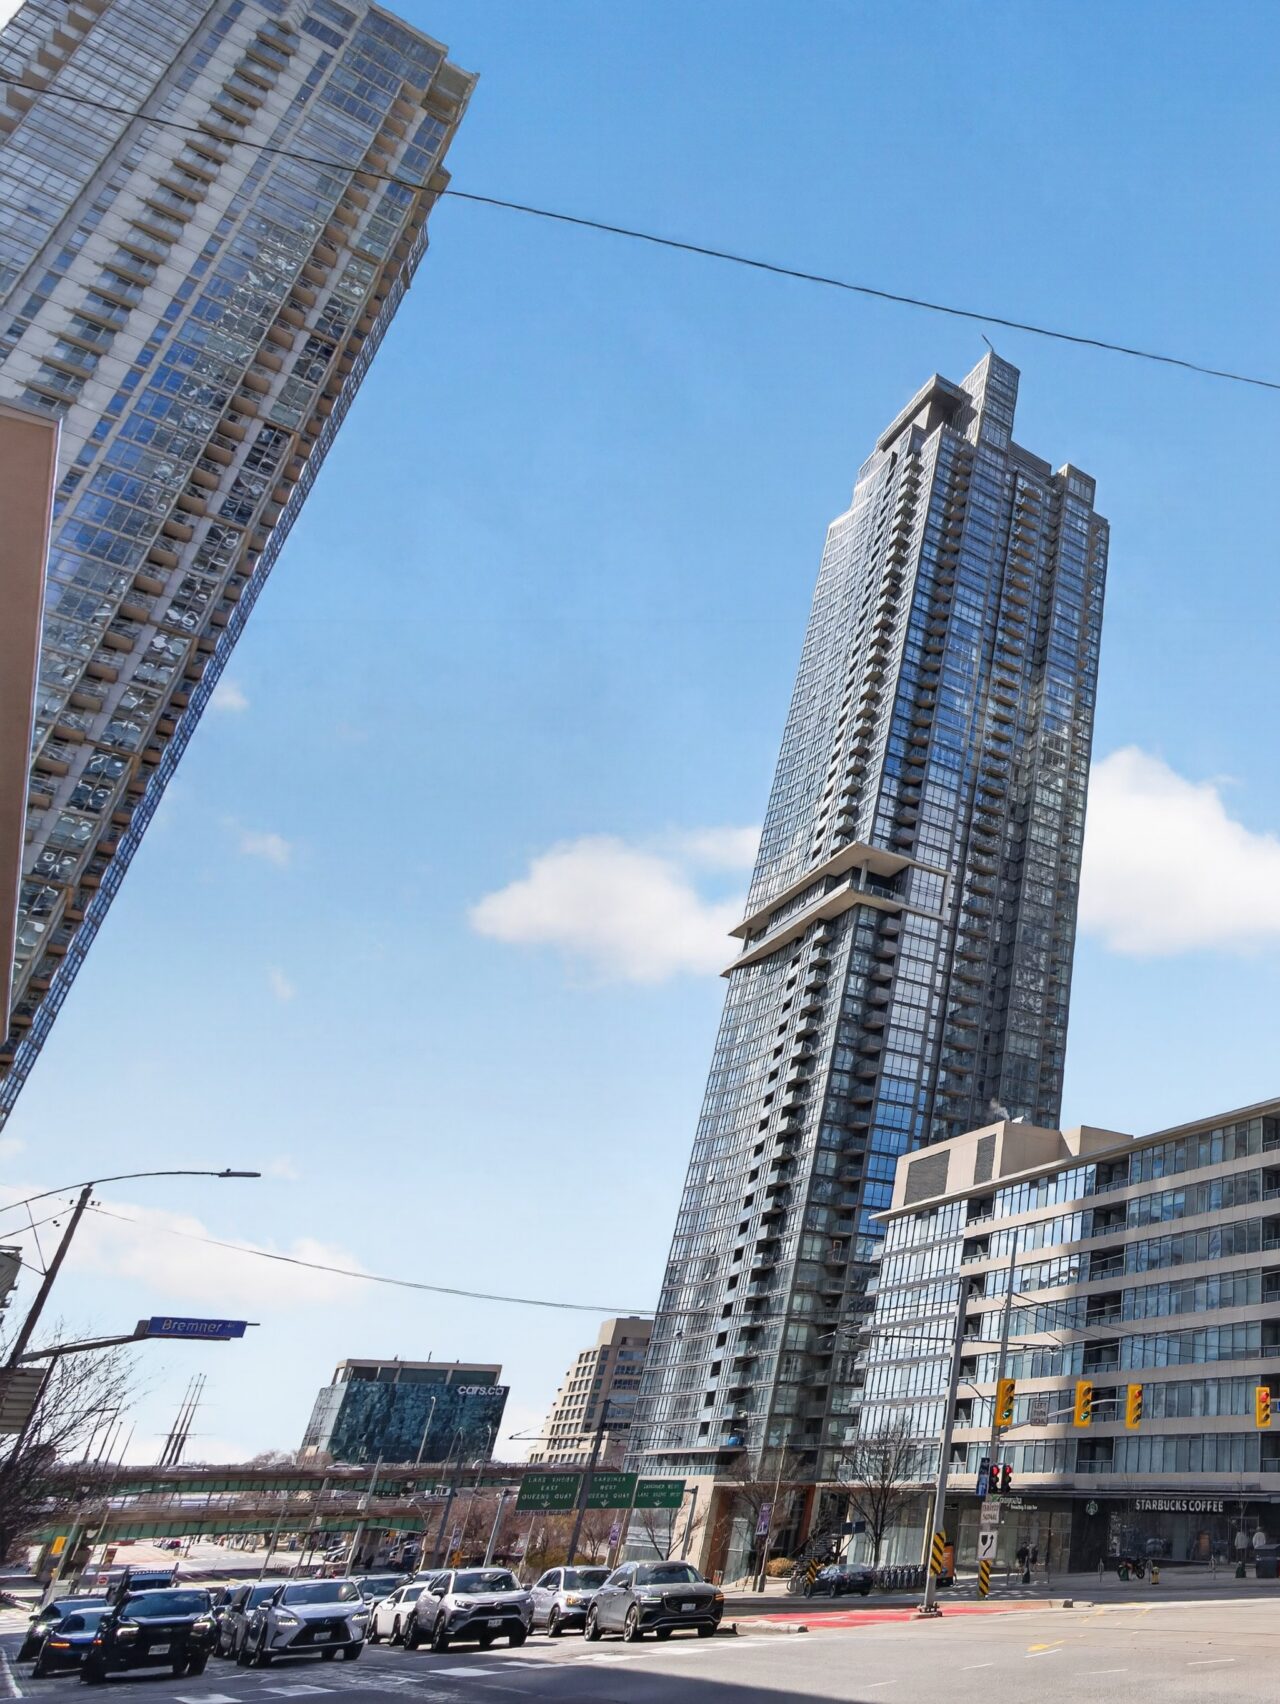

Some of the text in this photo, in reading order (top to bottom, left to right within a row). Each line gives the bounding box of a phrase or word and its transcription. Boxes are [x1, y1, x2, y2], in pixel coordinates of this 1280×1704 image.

[161, 1319, 222, 1333] Bremner
[456, 1385, 505, 1396] cars.ca
[1135, 1499, 1223, 1512] STARBUCKS COFFEE
